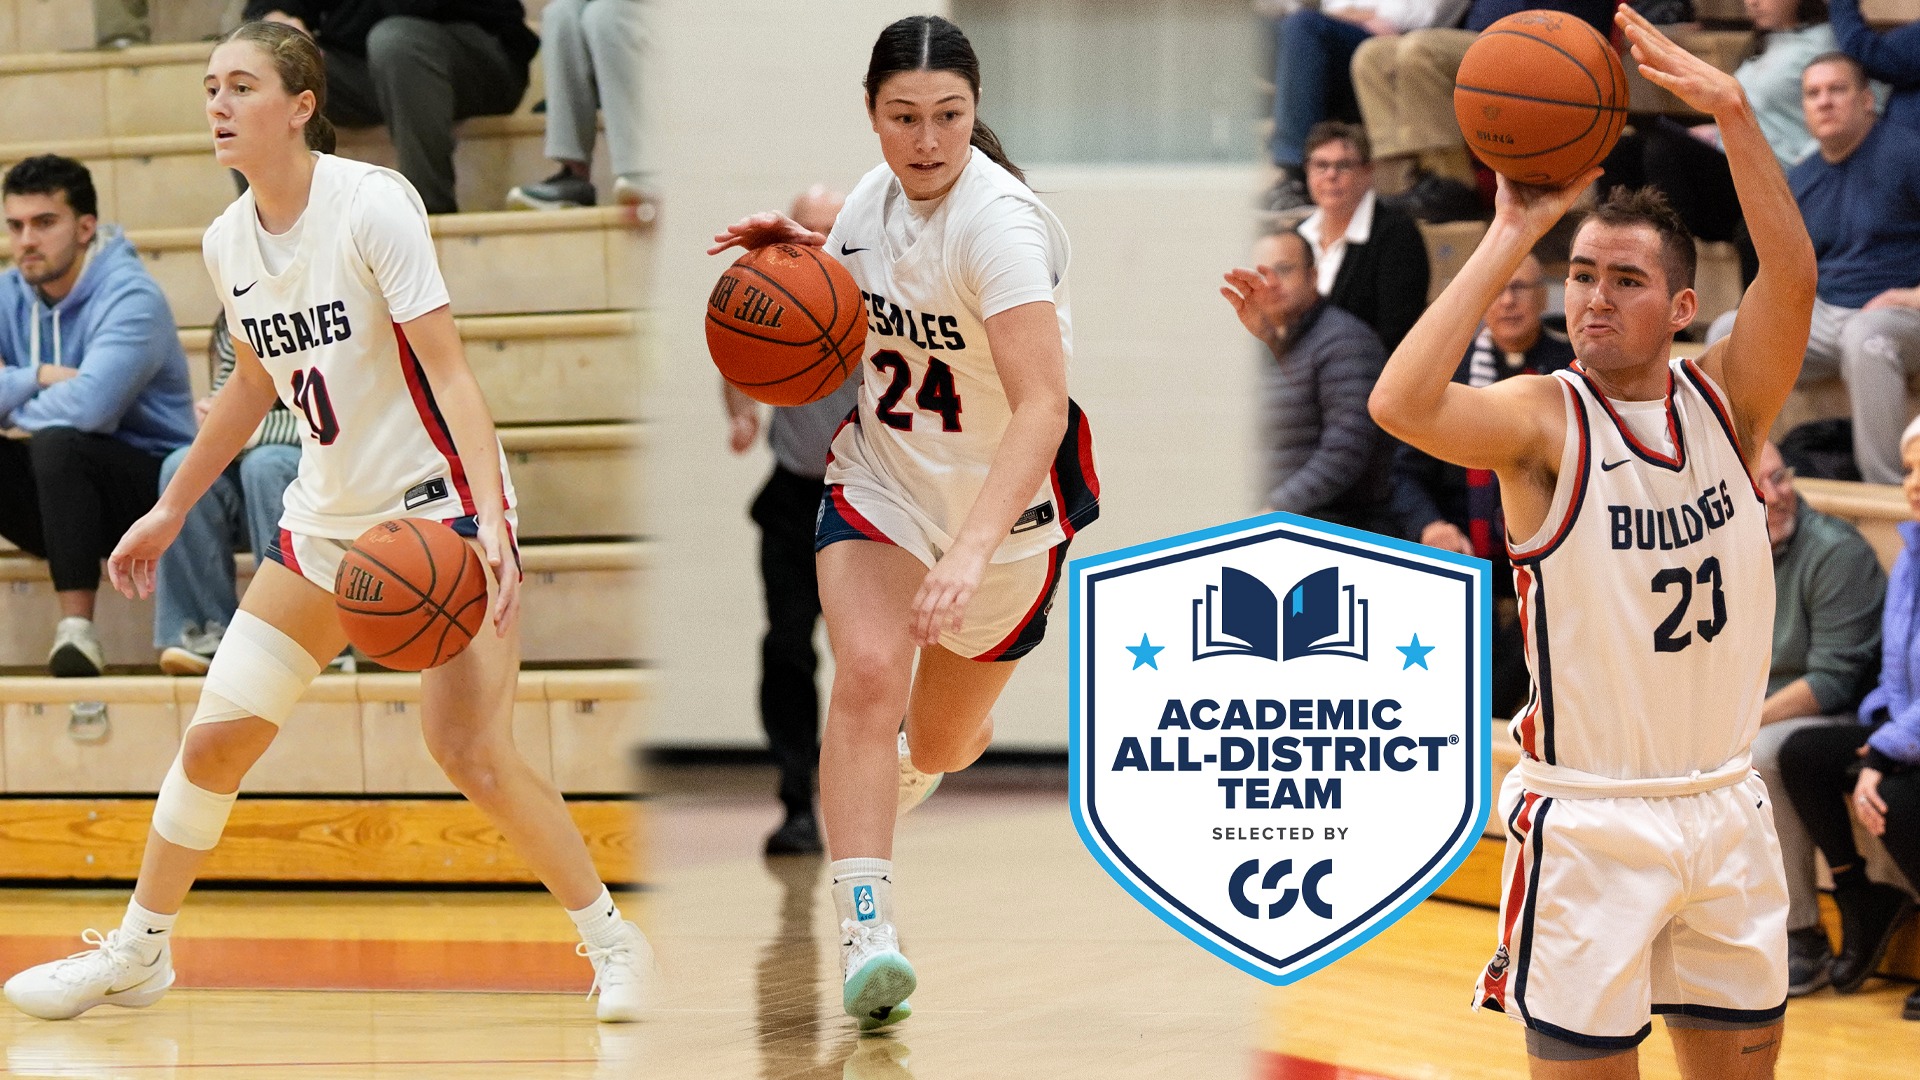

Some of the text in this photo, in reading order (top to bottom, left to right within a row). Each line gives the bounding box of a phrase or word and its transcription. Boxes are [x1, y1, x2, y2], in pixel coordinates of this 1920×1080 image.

[734, 284, 785, 328] THE
[290, 366, 340, 445] 10
[870, 348, 962, 432] 24
[432, 486, 440, 494] L
[1041, 511, 1049, 520] L
[345, 566, 384, 602] THE
[1651, 556, 1727, 652] 23
